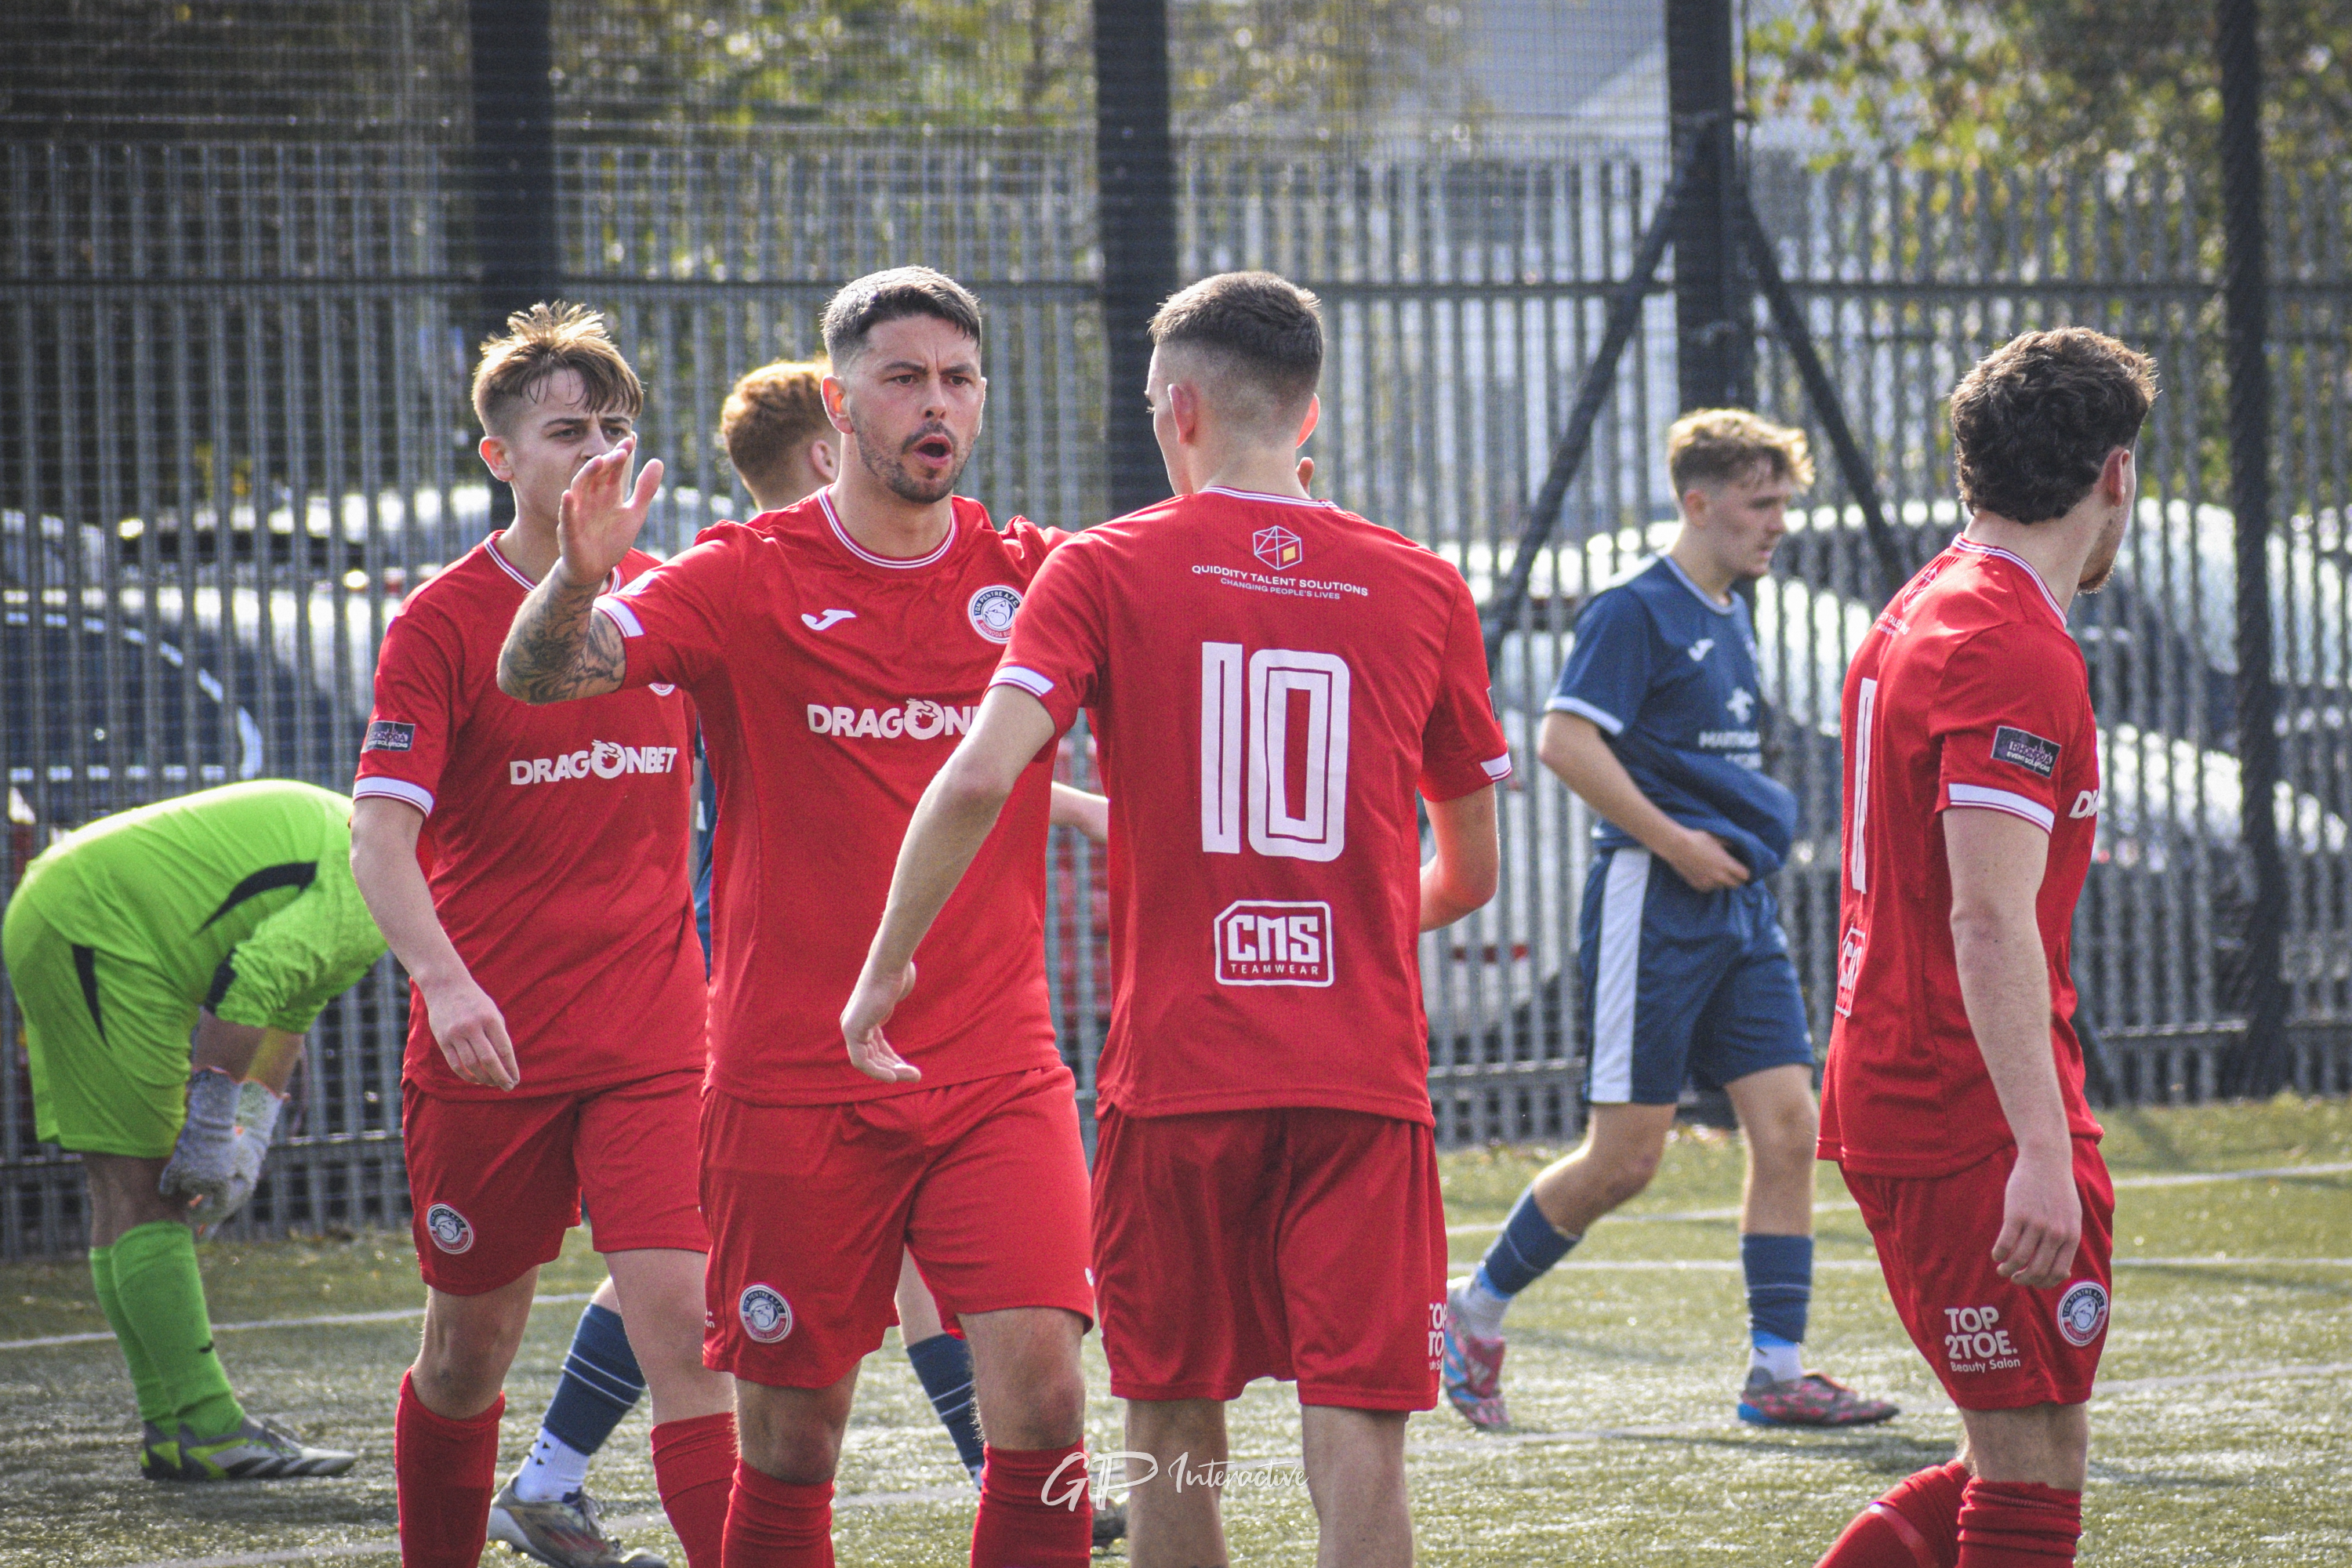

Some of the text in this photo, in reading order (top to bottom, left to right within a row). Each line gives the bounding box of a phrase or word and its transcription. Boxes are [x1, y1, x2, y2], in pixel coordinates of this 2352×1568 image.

[1192, 564, 1369, 597] QUIDDITY TALENT SOLUTIONS
[1220, 577, 1341, 600] CHANGING PEOPLE'S LIVES
[979, 591, 1003, 603] PENTRE
[807, 698, 982, 740] DRAGON
[510, 739, 677, 785] DRAGONBET
[1201, 641, 1350, 862] 10
[2006, 751, 2025, 761] EVENT
[1227, 914, 1320, 963] CMS
[1231, 964, 1319, 975] TEAMWEAR
[1944, 1306, 1999, 1333] TOP
[1950, 1358, 2021, 1373] Beauty Salon
